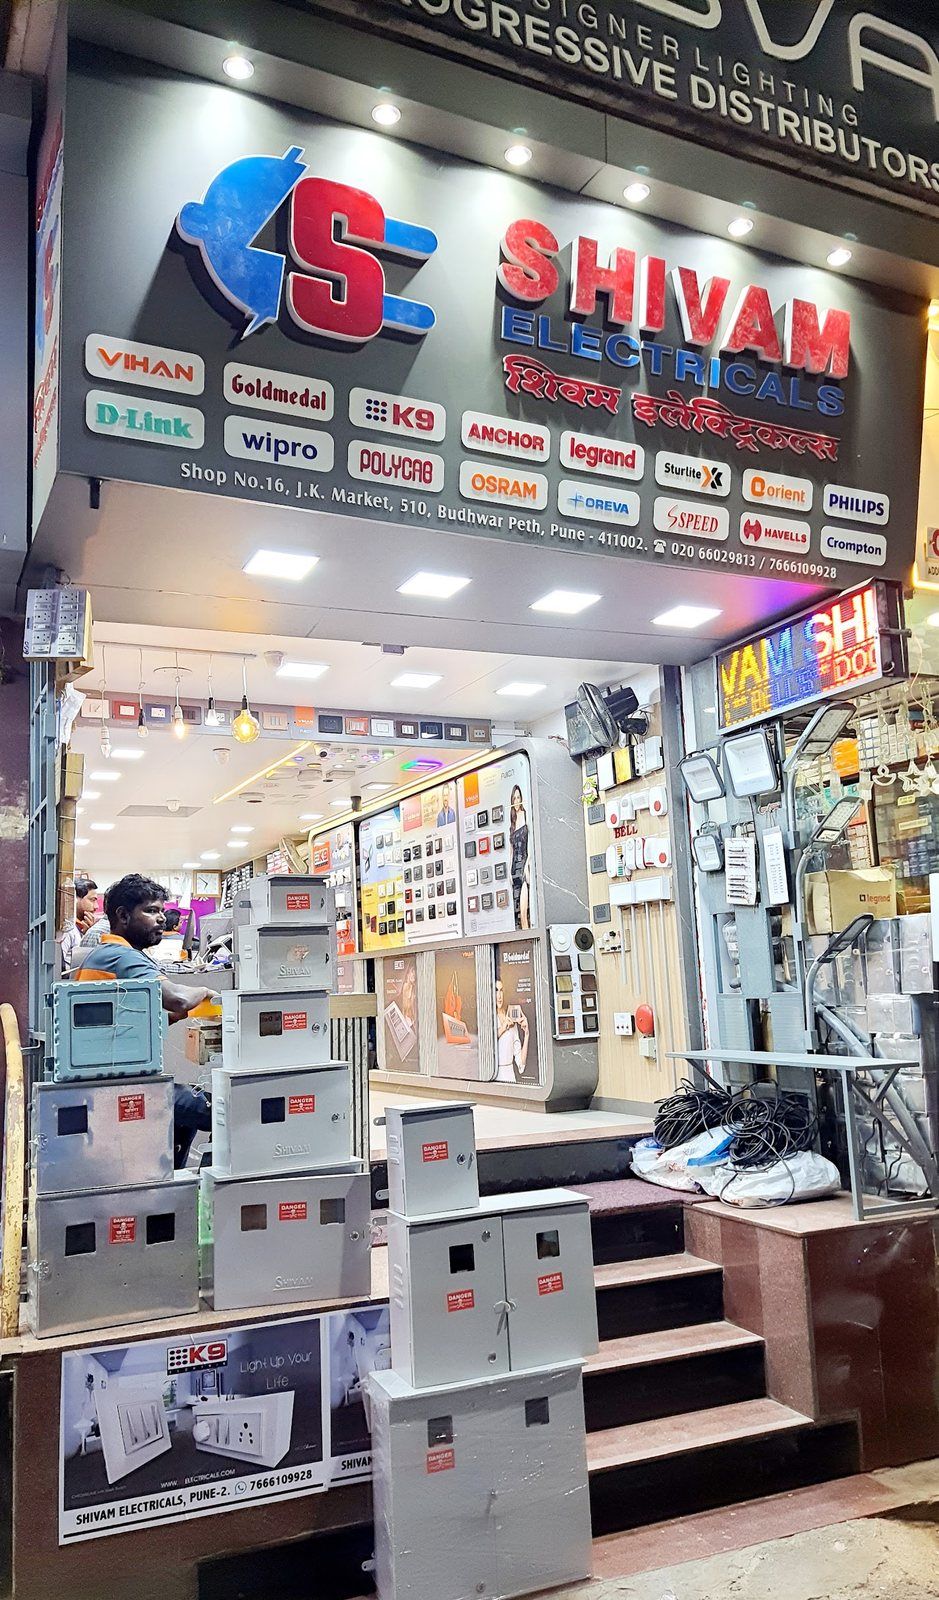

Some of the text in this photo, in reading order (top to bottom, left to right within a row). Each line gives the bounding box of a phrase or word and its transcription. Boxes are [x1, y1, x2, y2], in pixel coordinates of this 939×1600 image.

[695, 47, 859, 127] LIGHTING
[496, 219, 851, 380] SHIVAM
[97, 347, 194, 382] VIHAN
[500, 305, 845, 418] ELECTRICALS
[231, 374, 327, 411] Goldmedal
[502, 354, 622, 415] शिवम
[96, 402, 194, 439] D-Link
[392, 403, 435, 432] K9
[241, 431, 318, 462] wipro
[468, 422, 545, 451] ANCHOR
[359, 448, 434, 485] POLYCAB
[569, 437, 637, 469] legrand
[471, 473, 537, 500] OSRAM
[584, 496, 630, 515] OREVA
[829, 492, 884, 517] PHILIPS
[181, 462, 227, 487] Shop
[233, 471, 290, 497] No.16,
[295, 481, 325, 500] J.K.
[331, 487, 394, 512] Market,
[399, 499, 431, 519] 510,
[437, 504, 503, 528] Budhwar
[508, 515, 545, 537] Peth,
[550, 522, 585, 542] Pune
[597, 530, 648, 552] 411002.
[670, 541, 695, 559] 020
[698, 545, 756, 568] 66029813
[769, 557, 837, 579] 7666109928
[764, 526, 807, 543] HAVELLS
[826, 536, 882, 556] Crompton
[613, 824, 639, 839] BELL
[866, 893, 891, 904] legrand
[423, 1143, 447, 1152] DANGER
[281, 1203, 306, 1211] DANGER
[538, 1275, 561, 1285] DANGER
[448, 1292, 473, 1301] DANGER
[189, 1342, 226, 1364] K9
[428, 1451, 453, 1462] DANGER
[75, 1469, 313, 1525] SHIVAM ELECTRICALS, PUNE-2. 7666109928
